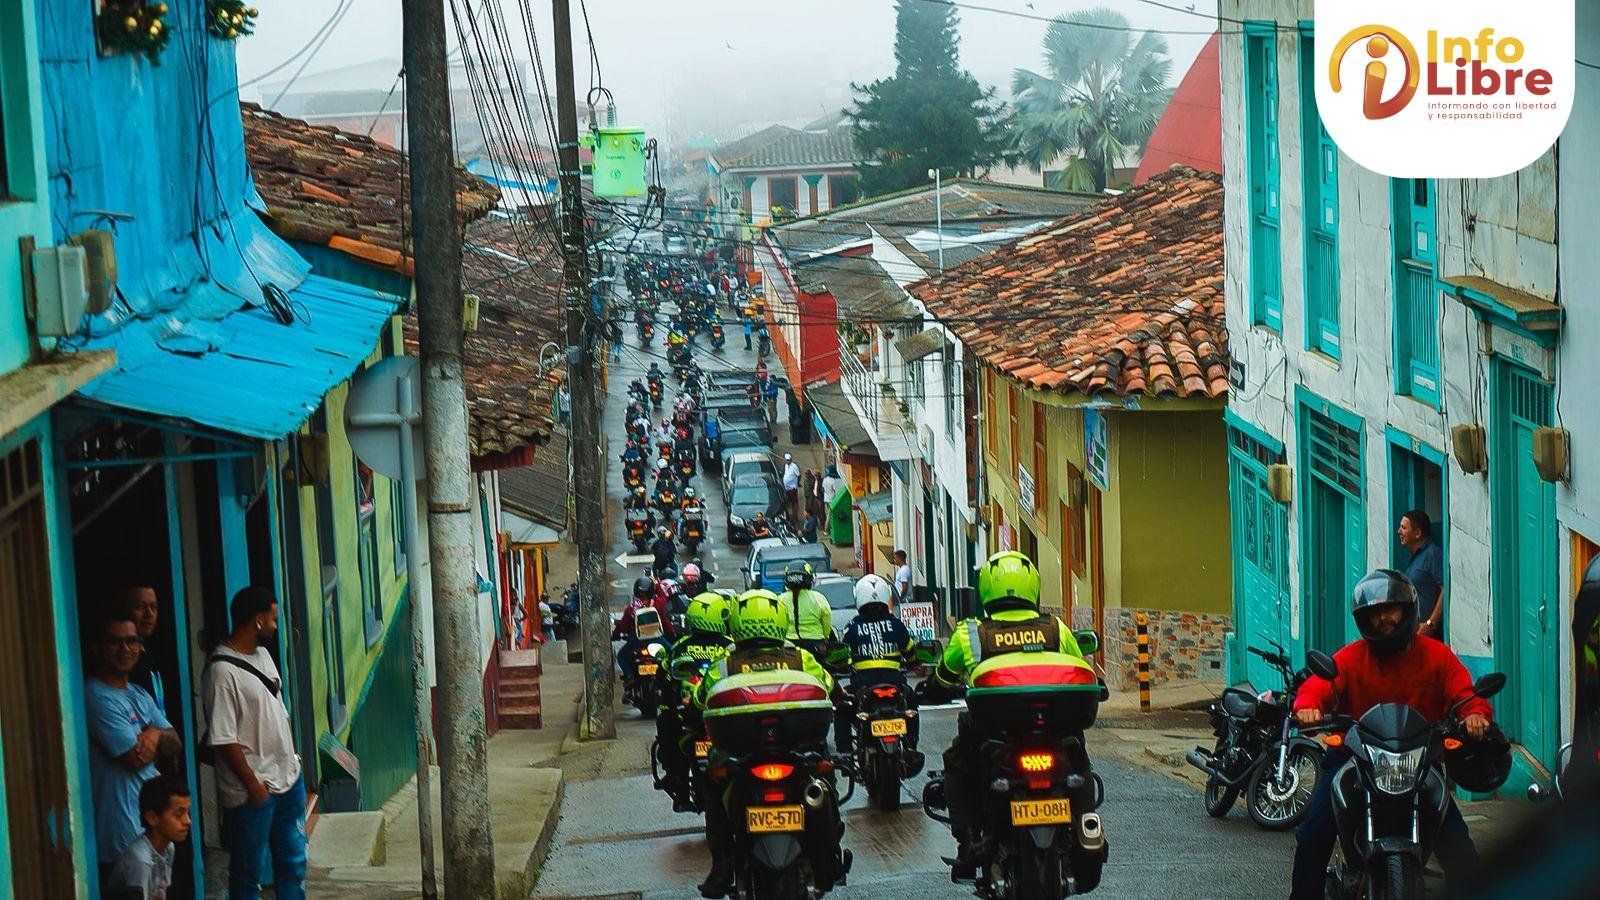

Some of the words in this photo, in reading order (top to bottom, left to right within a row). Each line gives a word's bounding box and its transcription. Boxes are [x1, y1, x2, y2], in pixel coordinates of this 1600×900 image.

[901, 606, 932, 618] COMPRA
[857, 620, 893, 637] AGENTE
[994, 630, 1046, 647] POLICIA
[750, 810, 801, 826] RVC-57D
[1013, 803, 1068, 819] HTJ-08H
